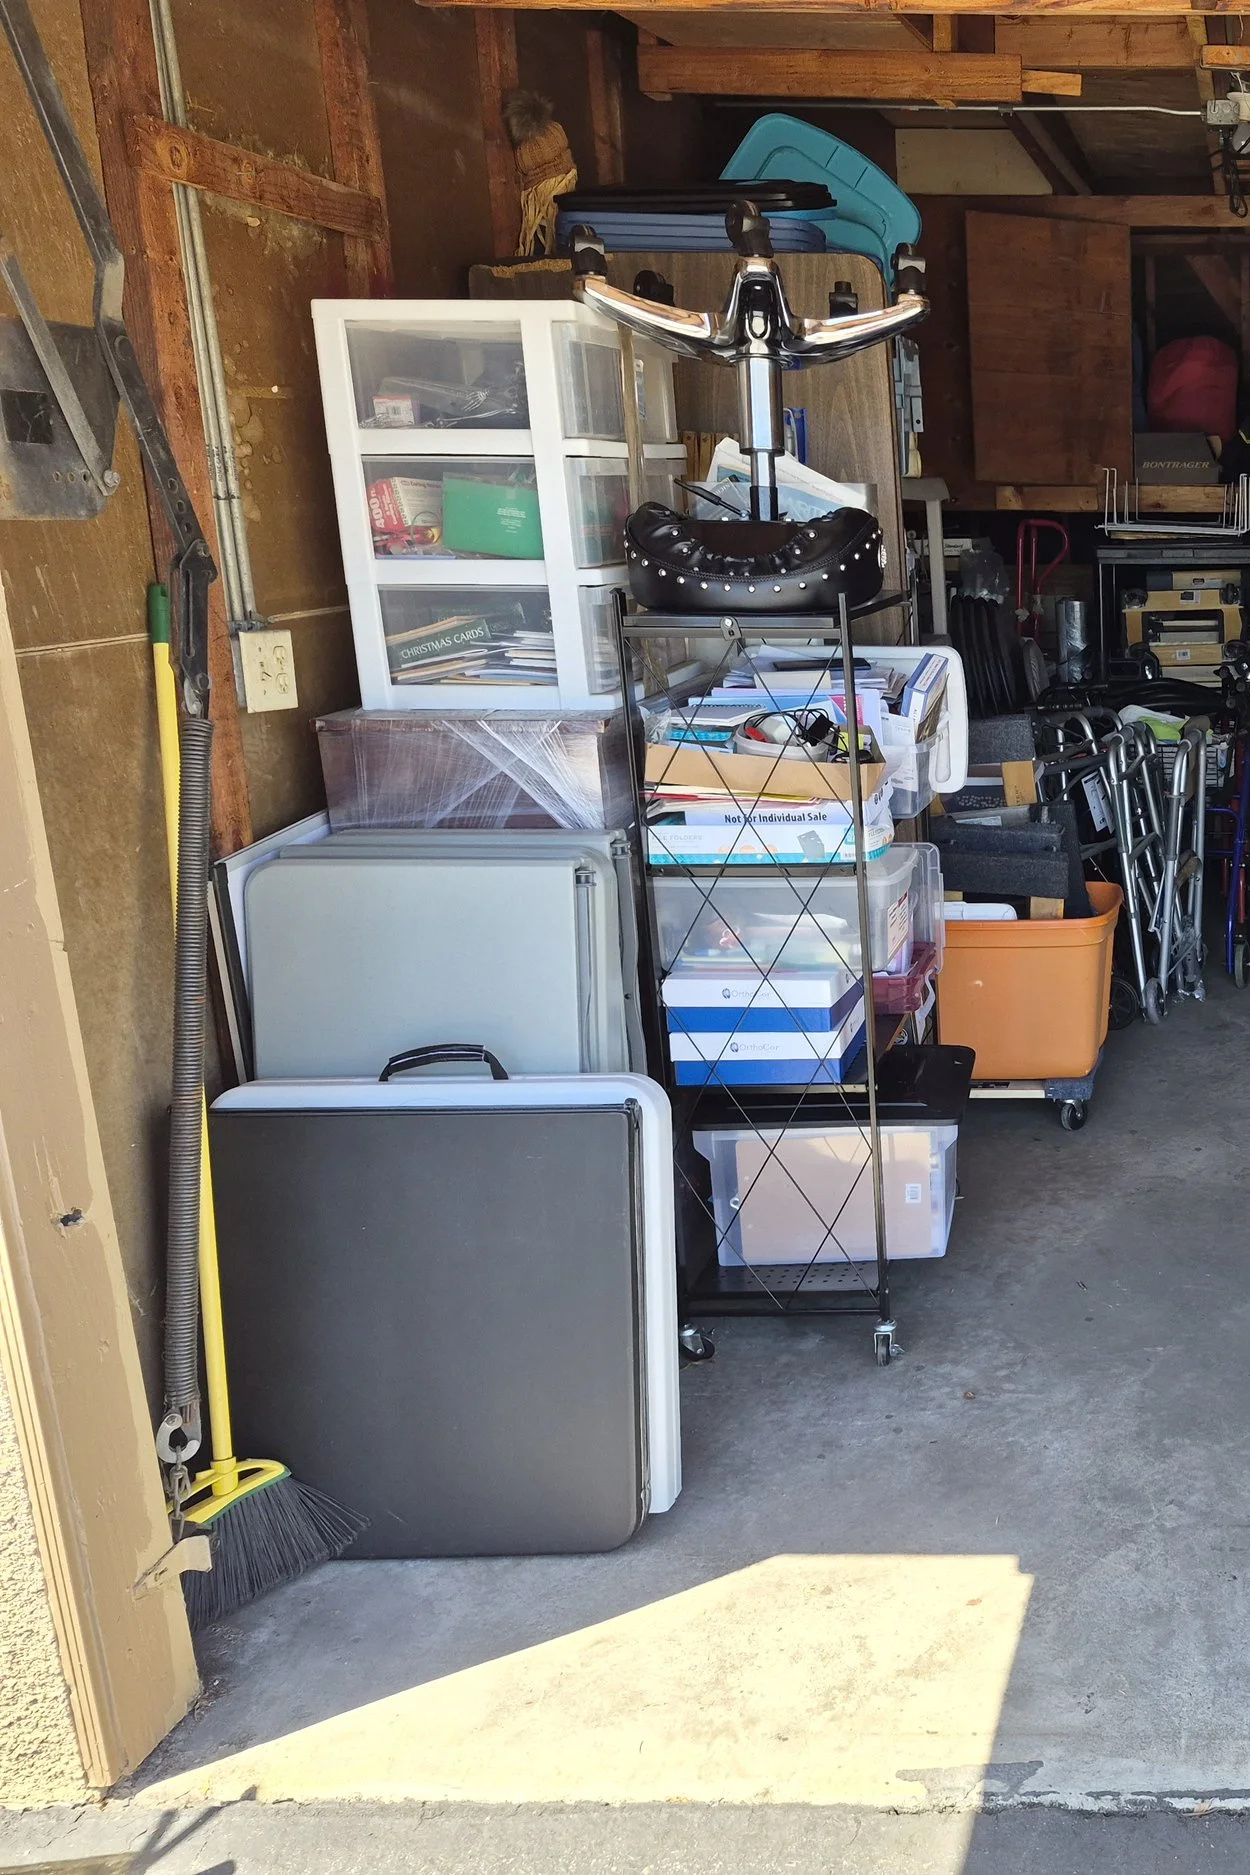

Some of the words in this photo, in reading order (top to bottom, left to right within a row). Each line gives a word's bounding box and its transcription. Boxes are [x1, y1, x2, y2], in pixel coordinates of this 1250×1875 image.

[1141, 460, 1210, 469] BONTRAGER
[400, 636, 452, 660] CHRISTMAS
[453, 626, 485, 644] CARDS
[724, 814, 742, 824] Not
[758, 813, 806, 823] Individual
[806, 812, 828, 822] Sale
